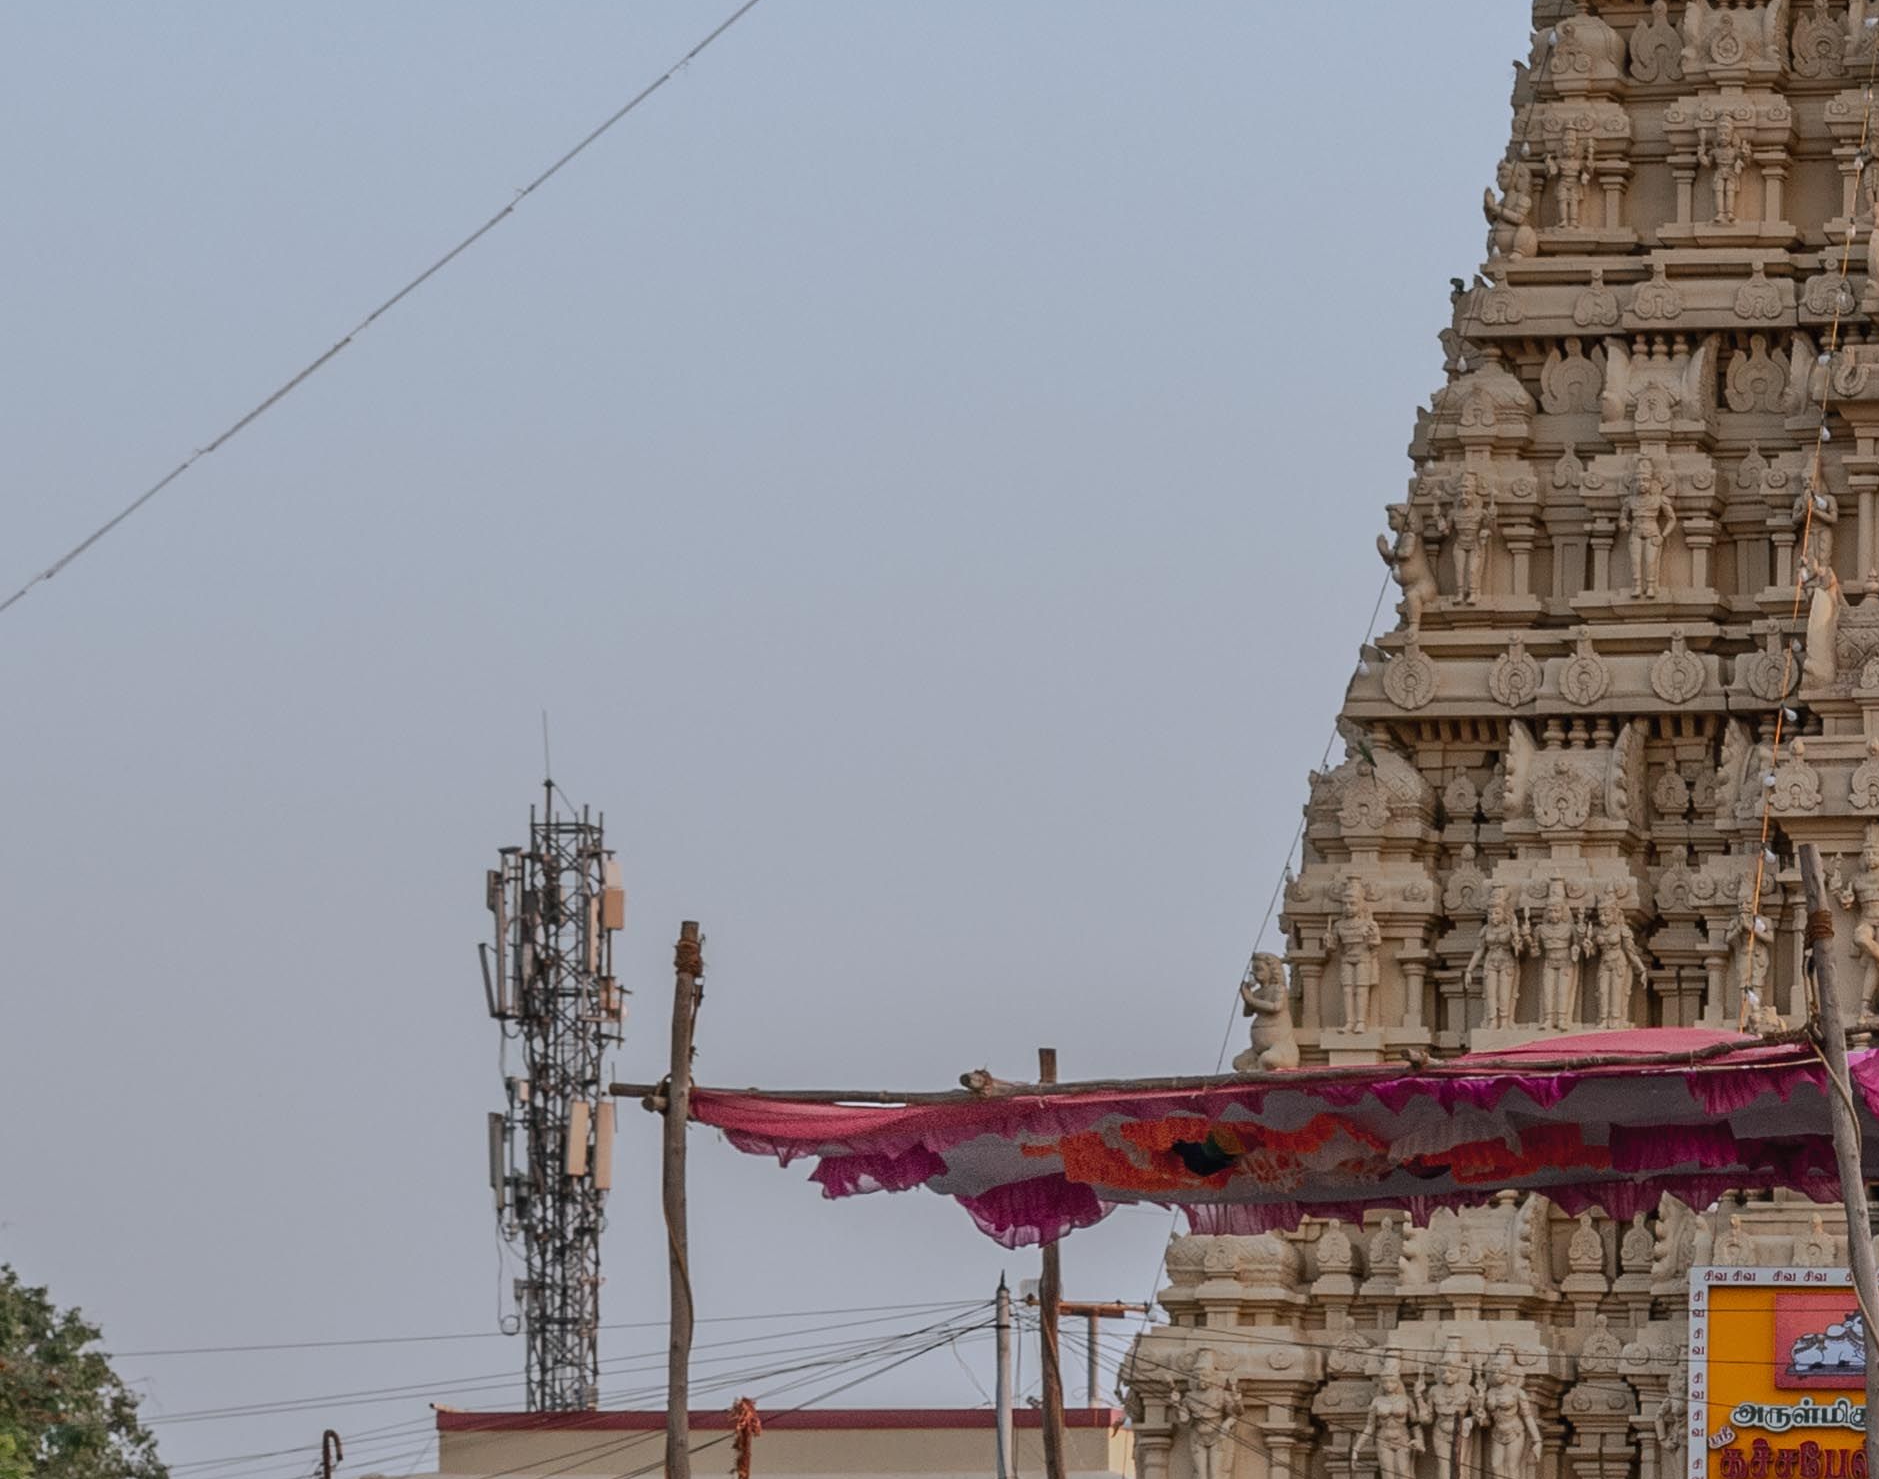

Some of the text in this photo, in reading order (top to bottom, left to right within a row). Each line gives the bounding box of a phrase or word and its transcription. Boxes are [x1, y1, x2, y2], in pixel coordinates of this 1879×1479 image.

[1704, 1270, 1727, 1282] சிவ
[1733, 1270, 1755, 1282] சிவ
[1772, 1270, 1795, 1282] சிவ
[1803, 1270, 1826, 1282] சிவ
